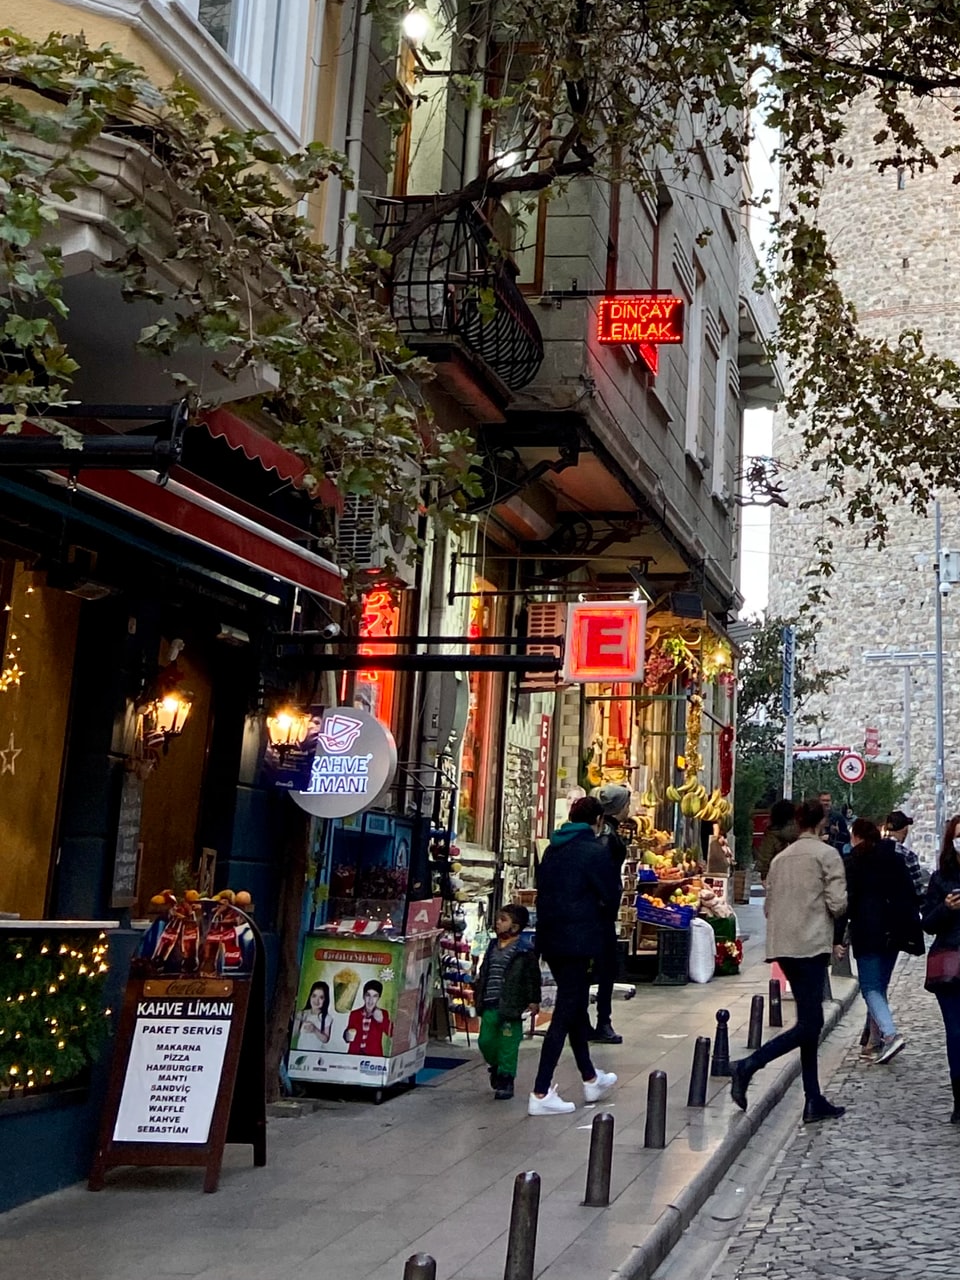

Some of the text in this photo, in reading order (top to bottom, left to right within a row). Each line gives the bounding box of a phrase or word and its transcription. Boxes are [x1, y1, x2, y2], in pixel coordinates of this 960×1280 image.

[611, 301, 673, 322] DİNÇAY
[611, 323, 672, 338] EMLAK
[585, 616, 625, 667] E
[136, 999, 234, 1016] KAHVE LİMANI
[142, 1024, 223, 1035] PAKET SERVİS
[156, 1044, 201, 1052] MAKARNA
[163, 1053, 190, 1061] PİZZA
[146, 1064, 204, 1072] HAMBURGER
[158, 1074, 188, 1082] MANTI
[150, 1083, 191, 1093] SANDVİÇ
[150, 1094, 187, 1102] PANKEK
[148, 1105, 185, 1113] WAFFLE
[149, 1115, 181, 1123] KAHVE
[137, 1125, 189, 1134] SEBASTİAN
